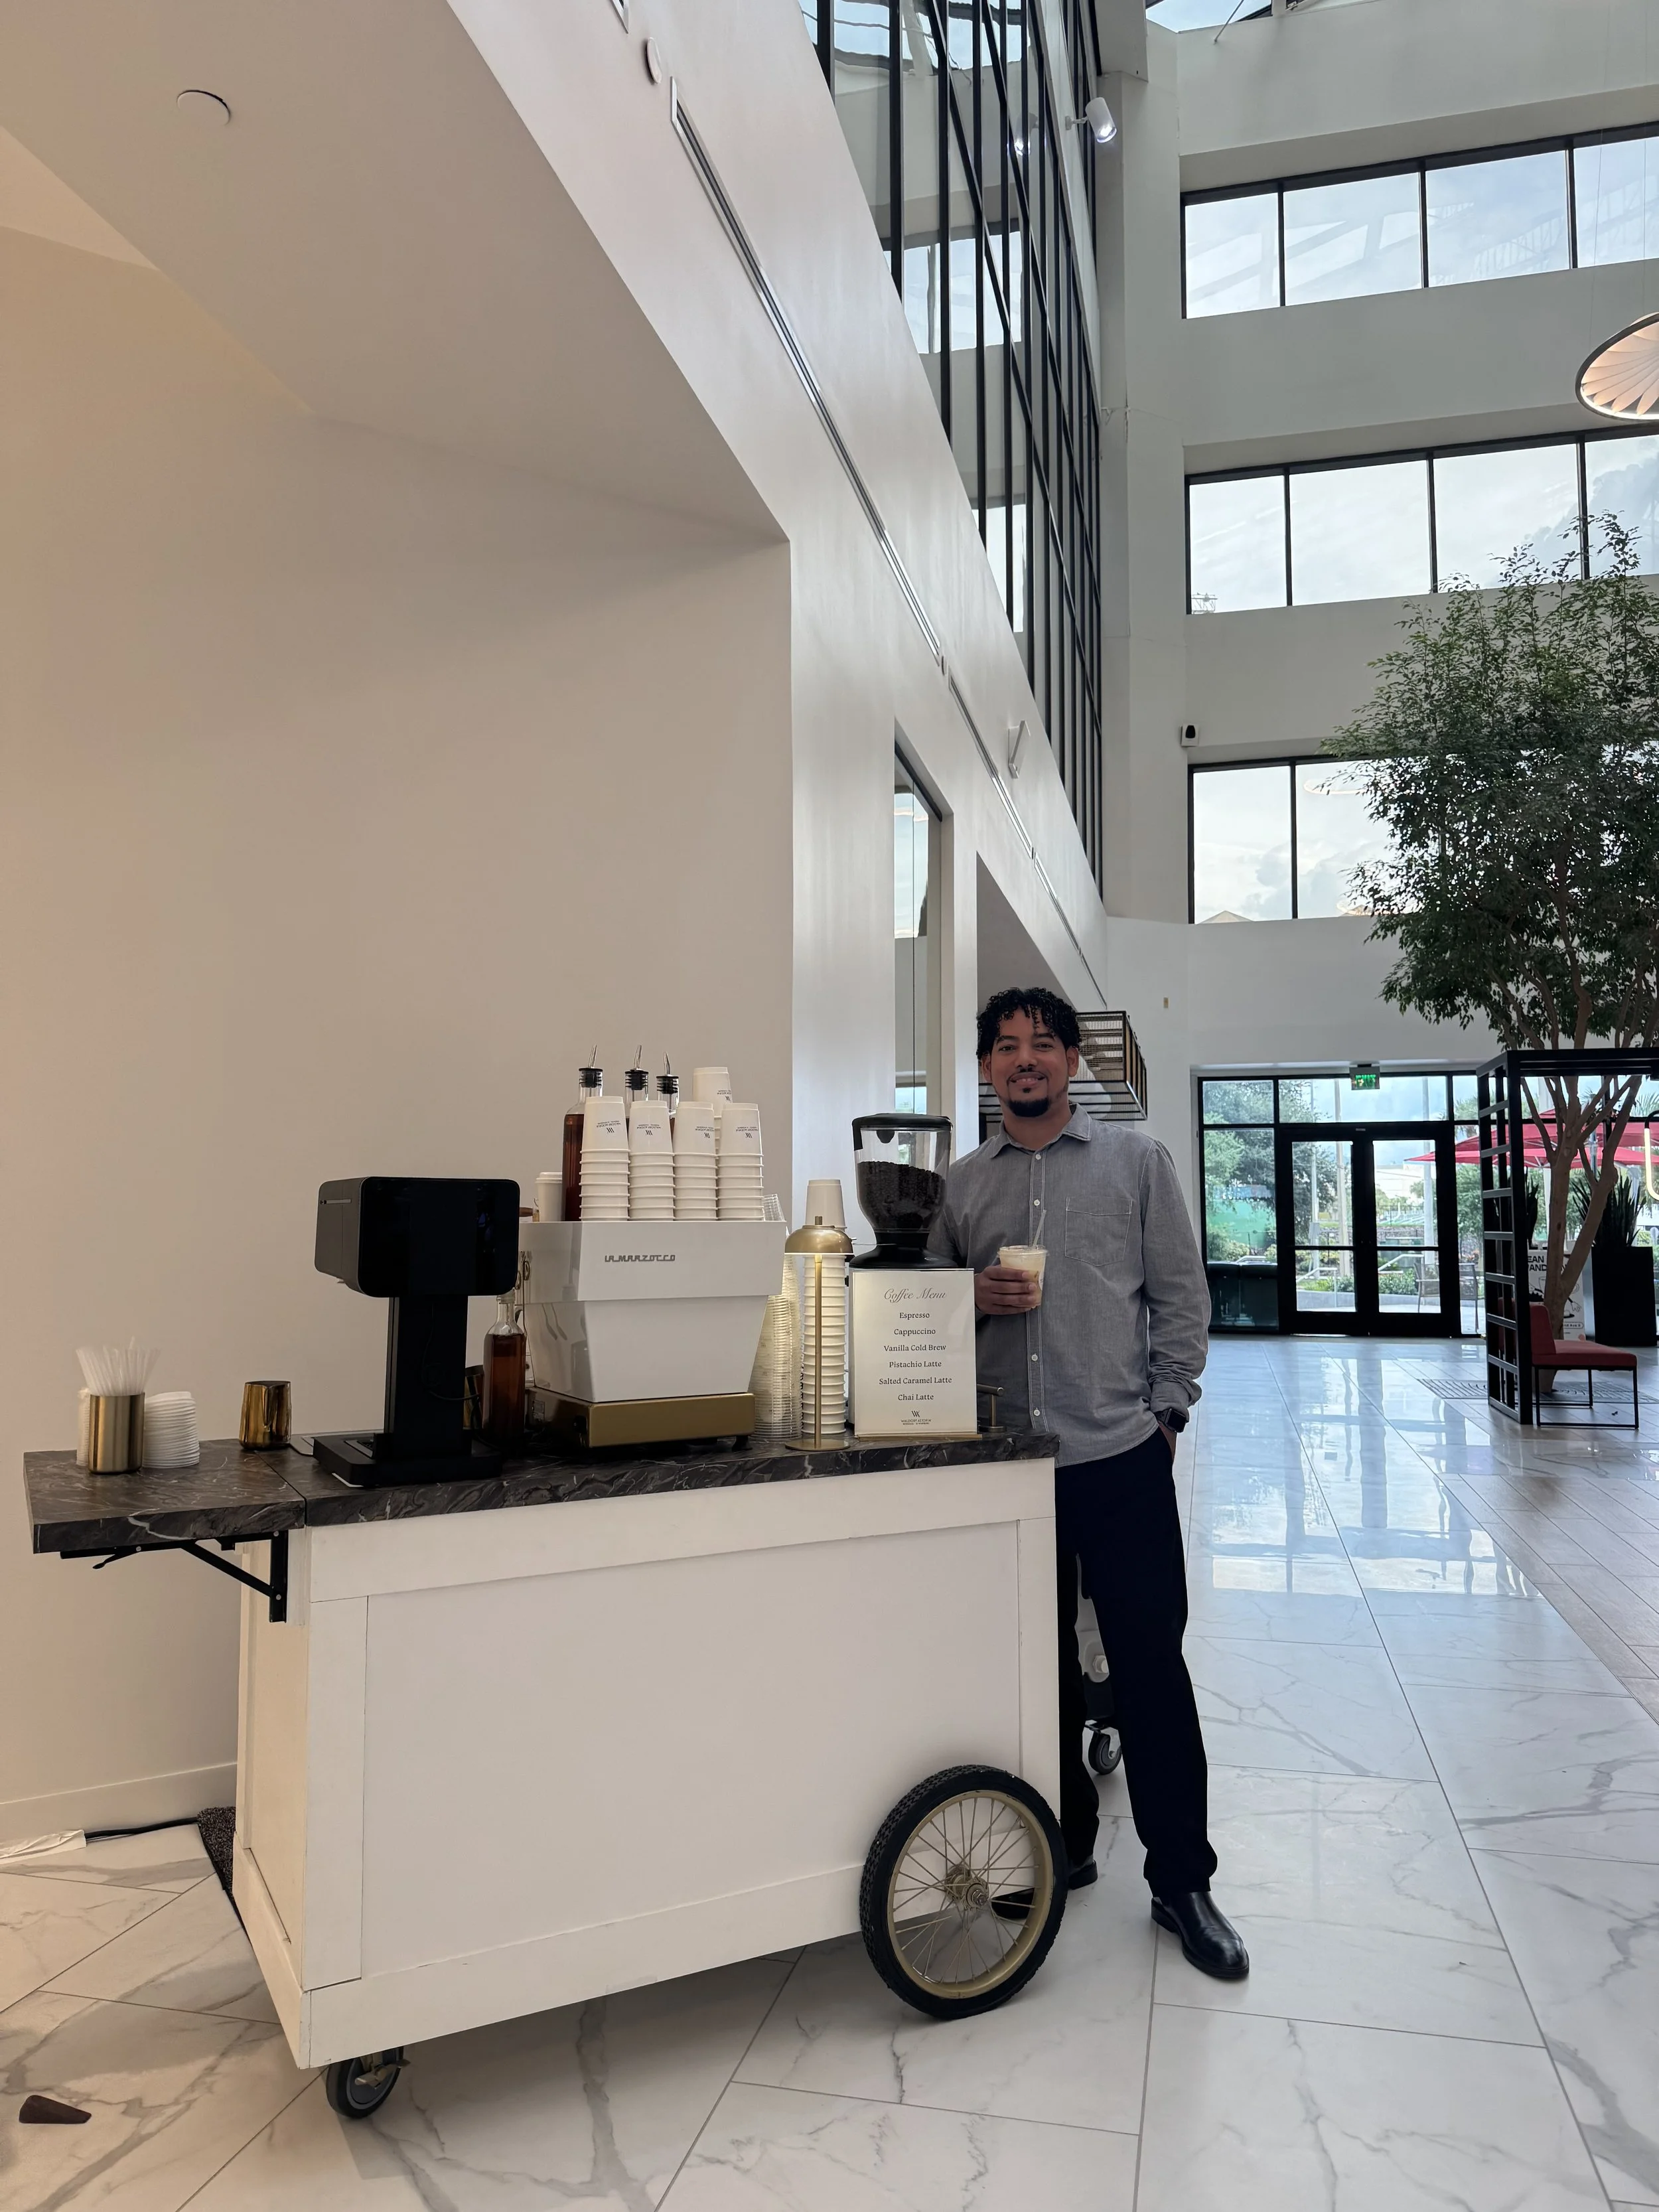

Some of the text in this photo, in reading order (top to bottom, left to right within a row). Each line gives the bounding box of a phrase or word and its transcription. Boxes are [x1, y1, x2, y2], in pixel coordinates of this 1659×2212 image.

[884, 1287, 946, 1303] Coffee Menu
[899, 1312, 930, 1321] Espresso
[894, 1328, 936, 1337] Cappuccino
